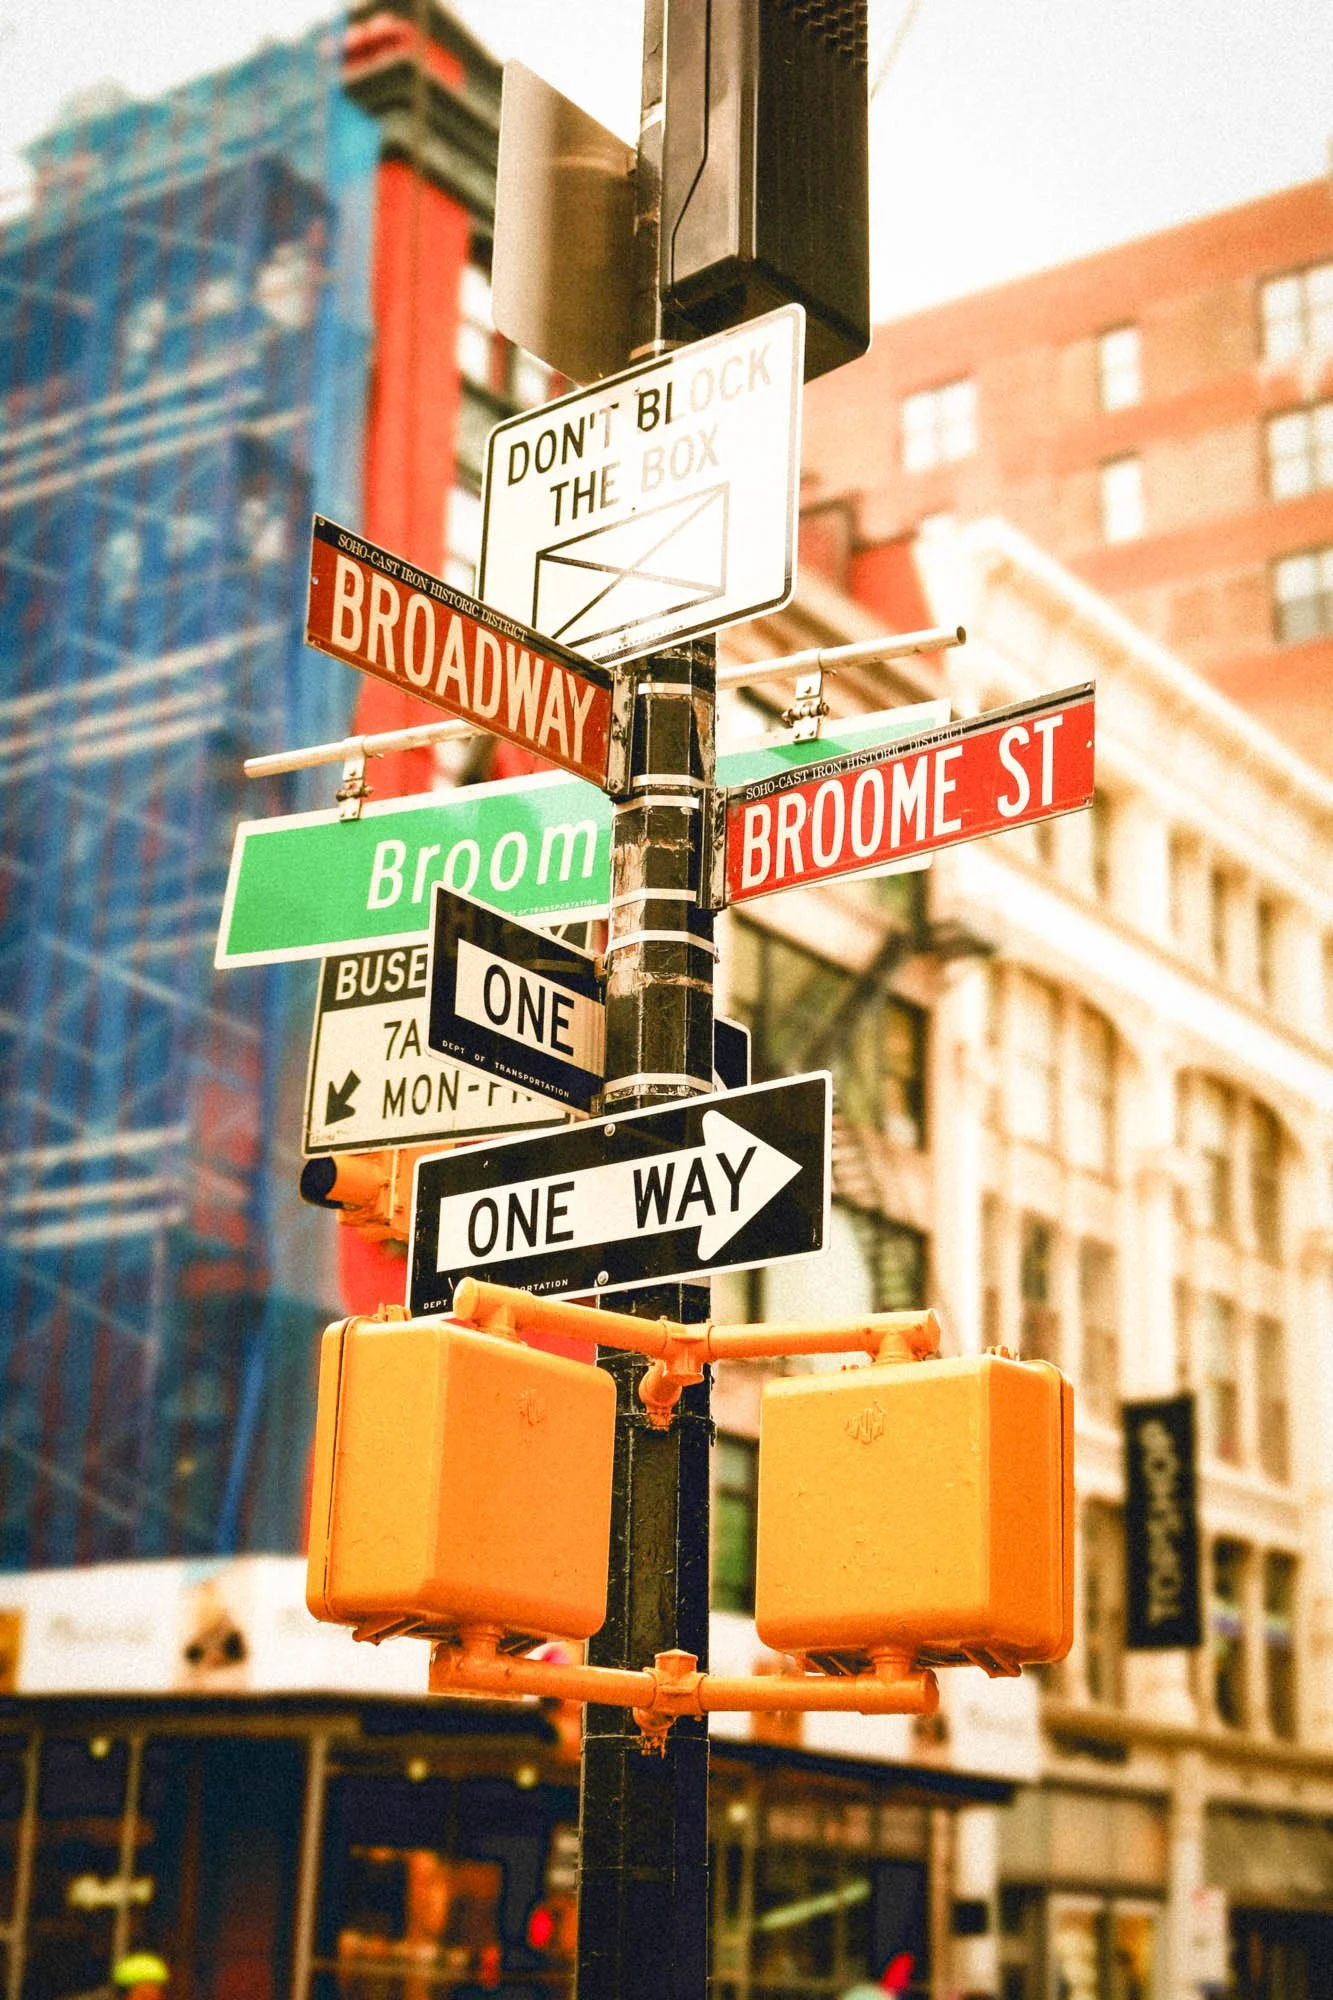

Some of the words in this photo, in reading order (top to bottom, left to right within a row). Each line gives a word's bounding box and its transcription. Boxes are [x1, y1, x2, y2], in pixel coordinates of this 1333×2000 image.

[507, 402, 620, 487] DON'T
[636, 343, 772, 434] BLOCK
[549, 461, 620, 528] THE
[640, 423, 720, 494] BOX
[338, 534, 400, 576] SOHO-CAST
[401, 566, 428, 591] IRON
[430, 581, 480, 617] HISTORIC
[481, 608, 528, 642] DISTRICT
[331, 554, 596, 764] BROADWAY
[741, 745, 963, 889] BROOME
[997, 714, 1063, 818] ST
[745, 771, 809, 800] SOHO-CAST
[811, 761, 843, 779] IRON
[846, 743, 904, 769] HISTORIC
[366, 818, 598, 910] Broom
[335, 948, 428, 1001] BUSE
[483, 964, 575, 1057] ONE
[384, 1018, 421, 1061] 7A
[442, 1040, 465, 1054] DEPT
[474, 1053, 486, 1063] OF
[494, 1061, 570, 1098] TRANSPORTATION
[467, 1181, 575, 1258] ONE
[632, 1146, 758, 1229] WAY
[423, 1299, 448, 1310] DEPT
